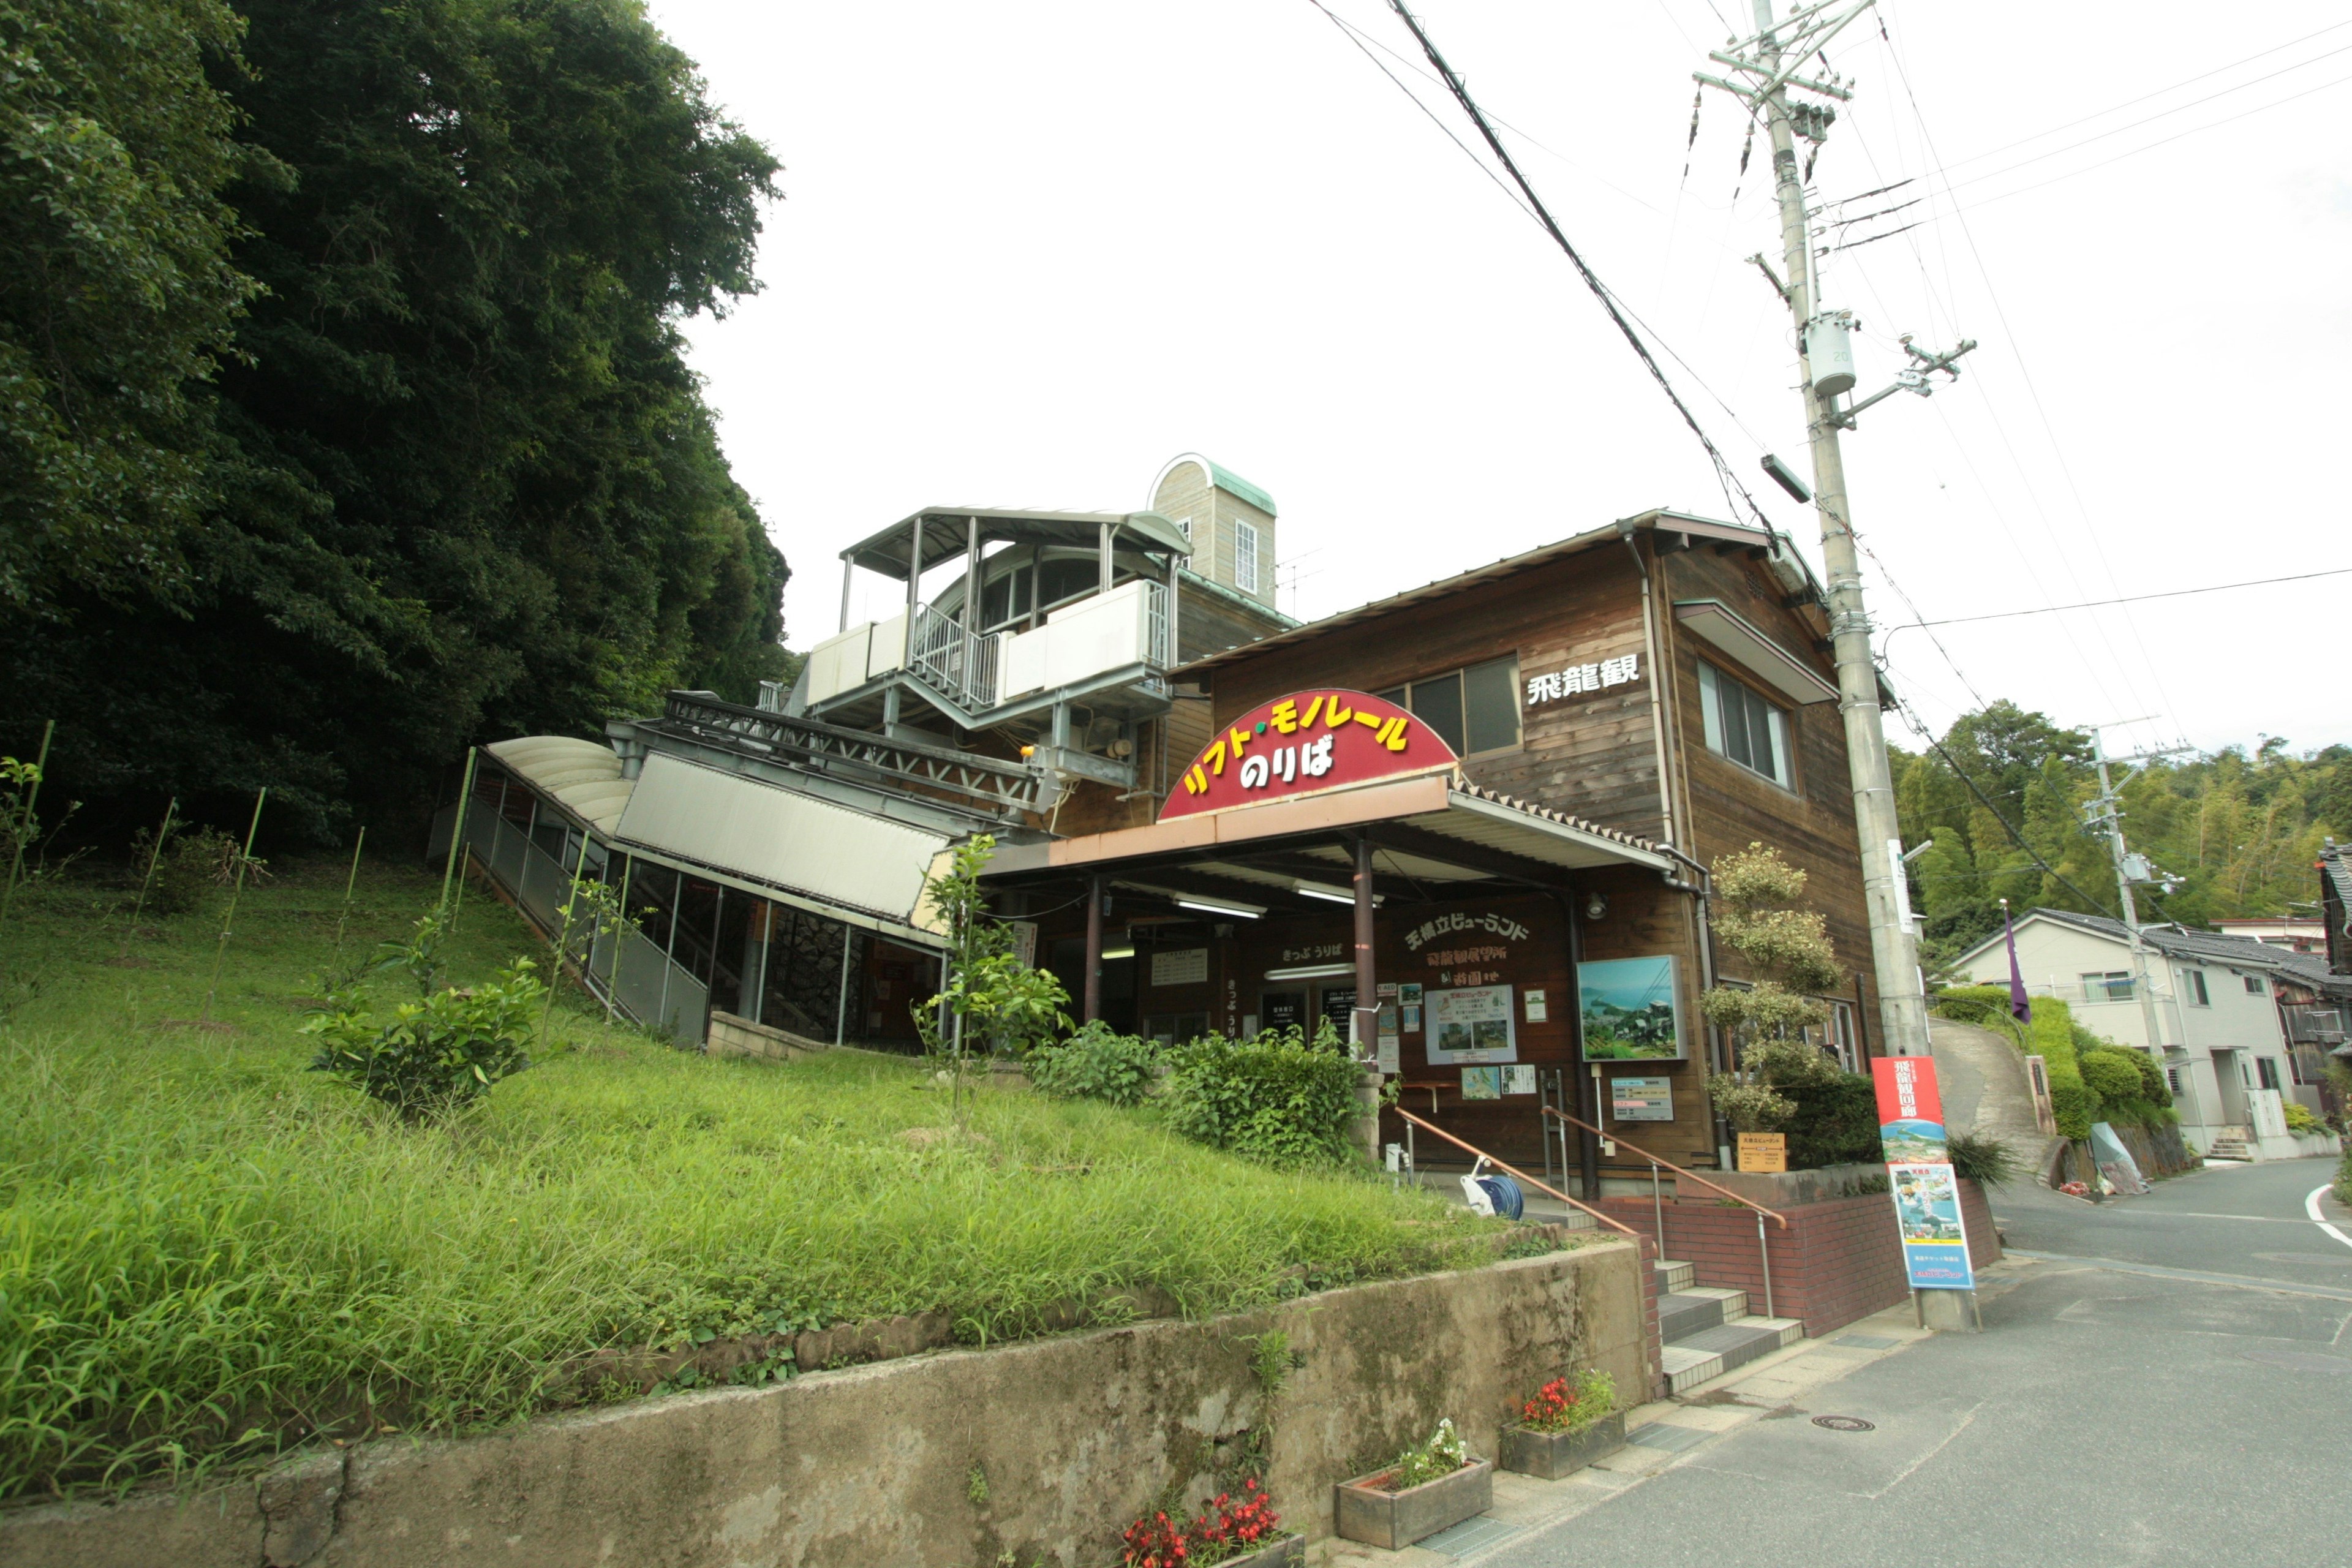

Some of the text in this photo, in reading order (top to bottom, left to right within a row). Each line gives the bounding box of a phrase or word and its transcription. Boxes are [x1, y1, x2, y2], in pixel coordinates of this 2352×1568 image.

[1833, 351, 1849, 363] 20
[1528, 654, 1639, 706] 飛龍観
[1183, 695, 1408, 795] リフト・モノレール
[1239, 733, 1335, 789] のりば
[1404, 913, 1530, 951] 天橋立ビューランド
[1426, 946, 1507, 967] 飛龍観展望所
[1453, 970, 1499, 986] 遊園地
[1894, 1060, 1917, 1117] 飛龍観回廊
